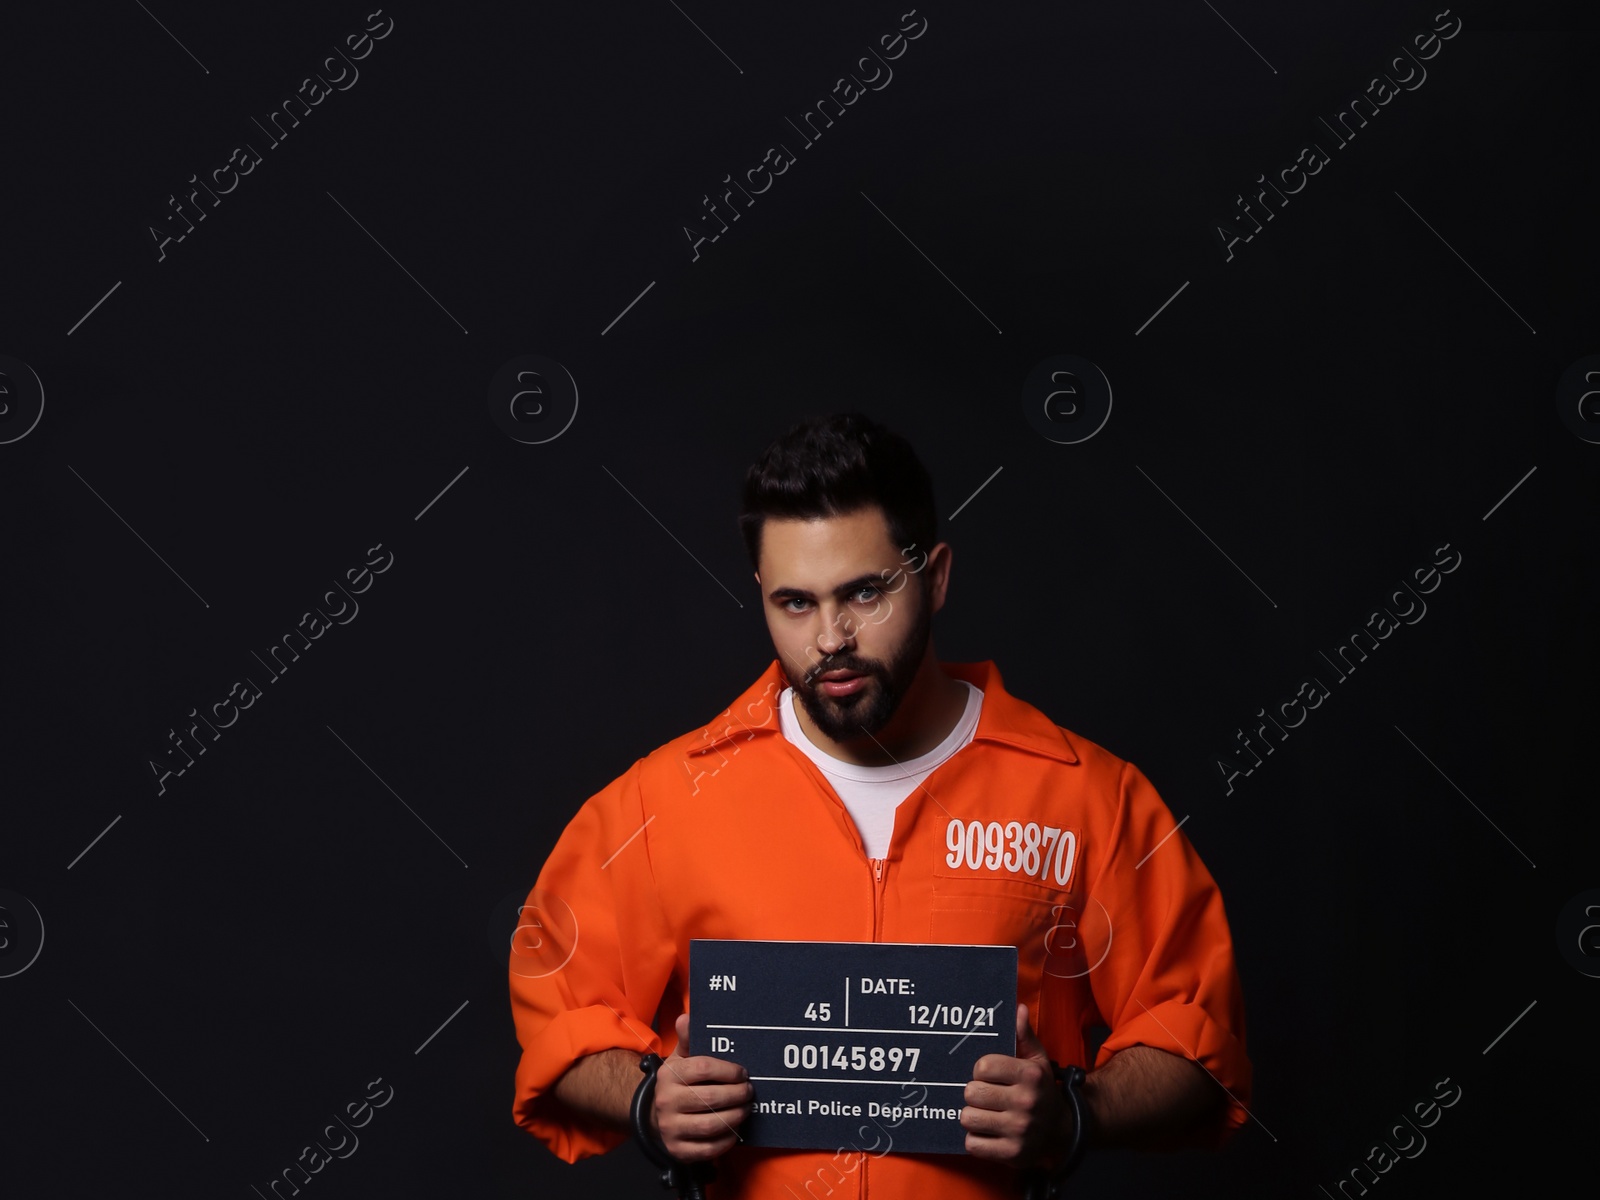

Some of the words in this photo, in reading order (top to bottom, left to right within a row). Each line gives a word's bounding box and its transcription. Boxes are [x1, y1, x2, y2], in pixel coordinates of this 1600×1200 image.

[946, 819, 1076, 886] 9093870
[709, 975, 737, 991] #N
[861, 978, 915, 995] DATE:
[804, 1002, 831, 1022] 45
[908, 1004, 994, 1029] 12/10/21
[711, 1037, 735, 1053] ID:
[783, 1044, 921, 1073] 00145897
[751, 1100, 802, 1115] entral
[808, 1100, 862, 1117] Police
[868, 1102, 962, 1121] Departme
